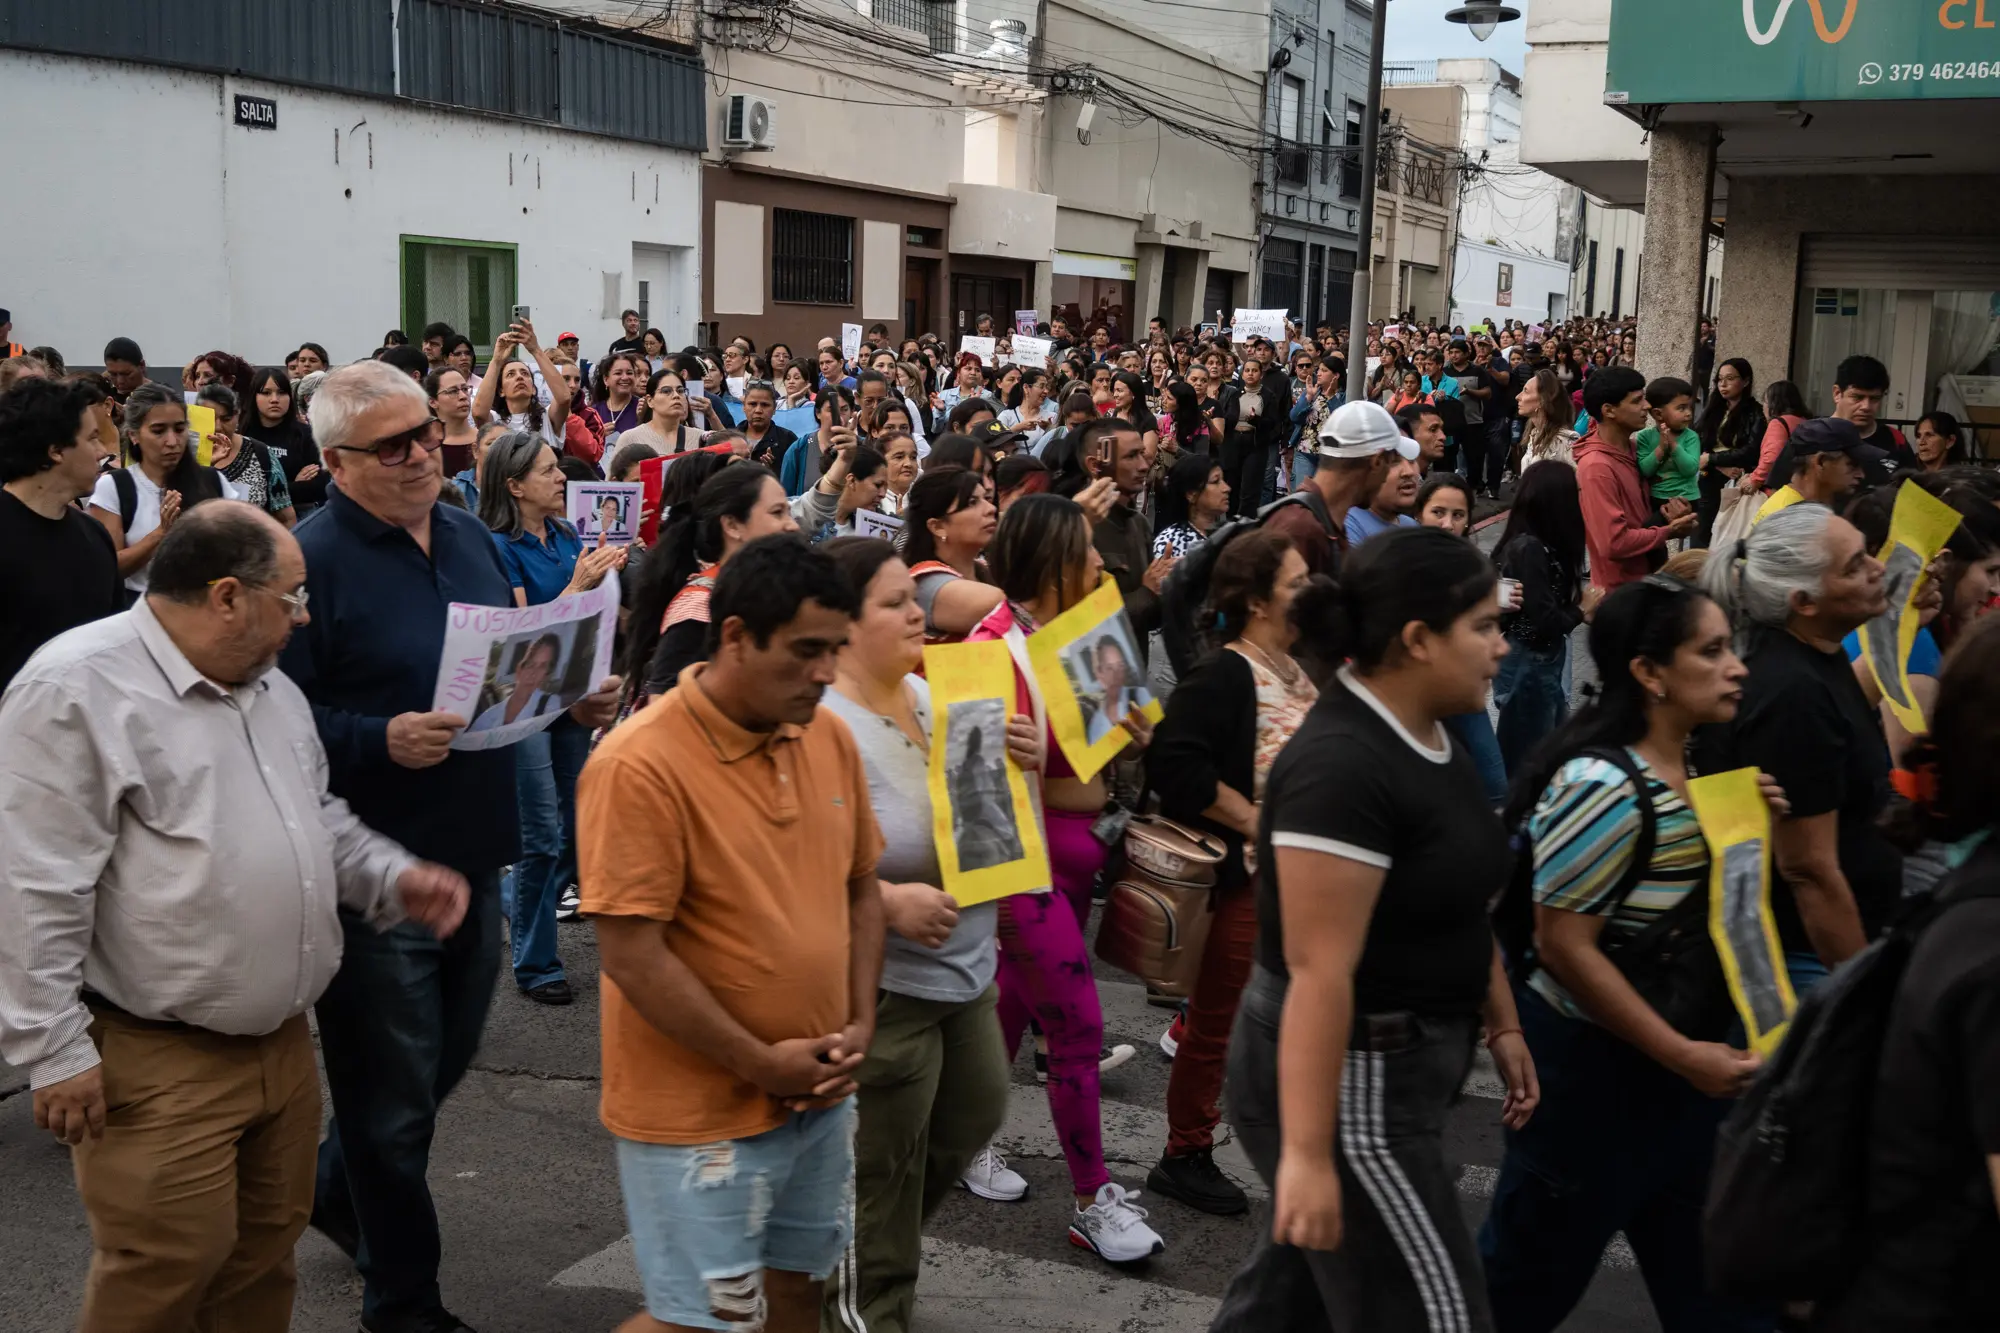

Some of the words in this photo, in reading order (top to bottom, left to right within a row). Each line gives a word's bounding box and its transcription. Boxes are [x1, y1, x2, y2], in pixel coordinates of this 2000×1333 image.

[1938, 0, 1995, 29] CL
[1889, 64, 1924, 81] 379
[1930, 61, 2000, 80] 462464
[241, 101, 274, 123] SALTA
[1249, 325, 1272, 334] NANCY
[447, 656, 486, 701] UNA
